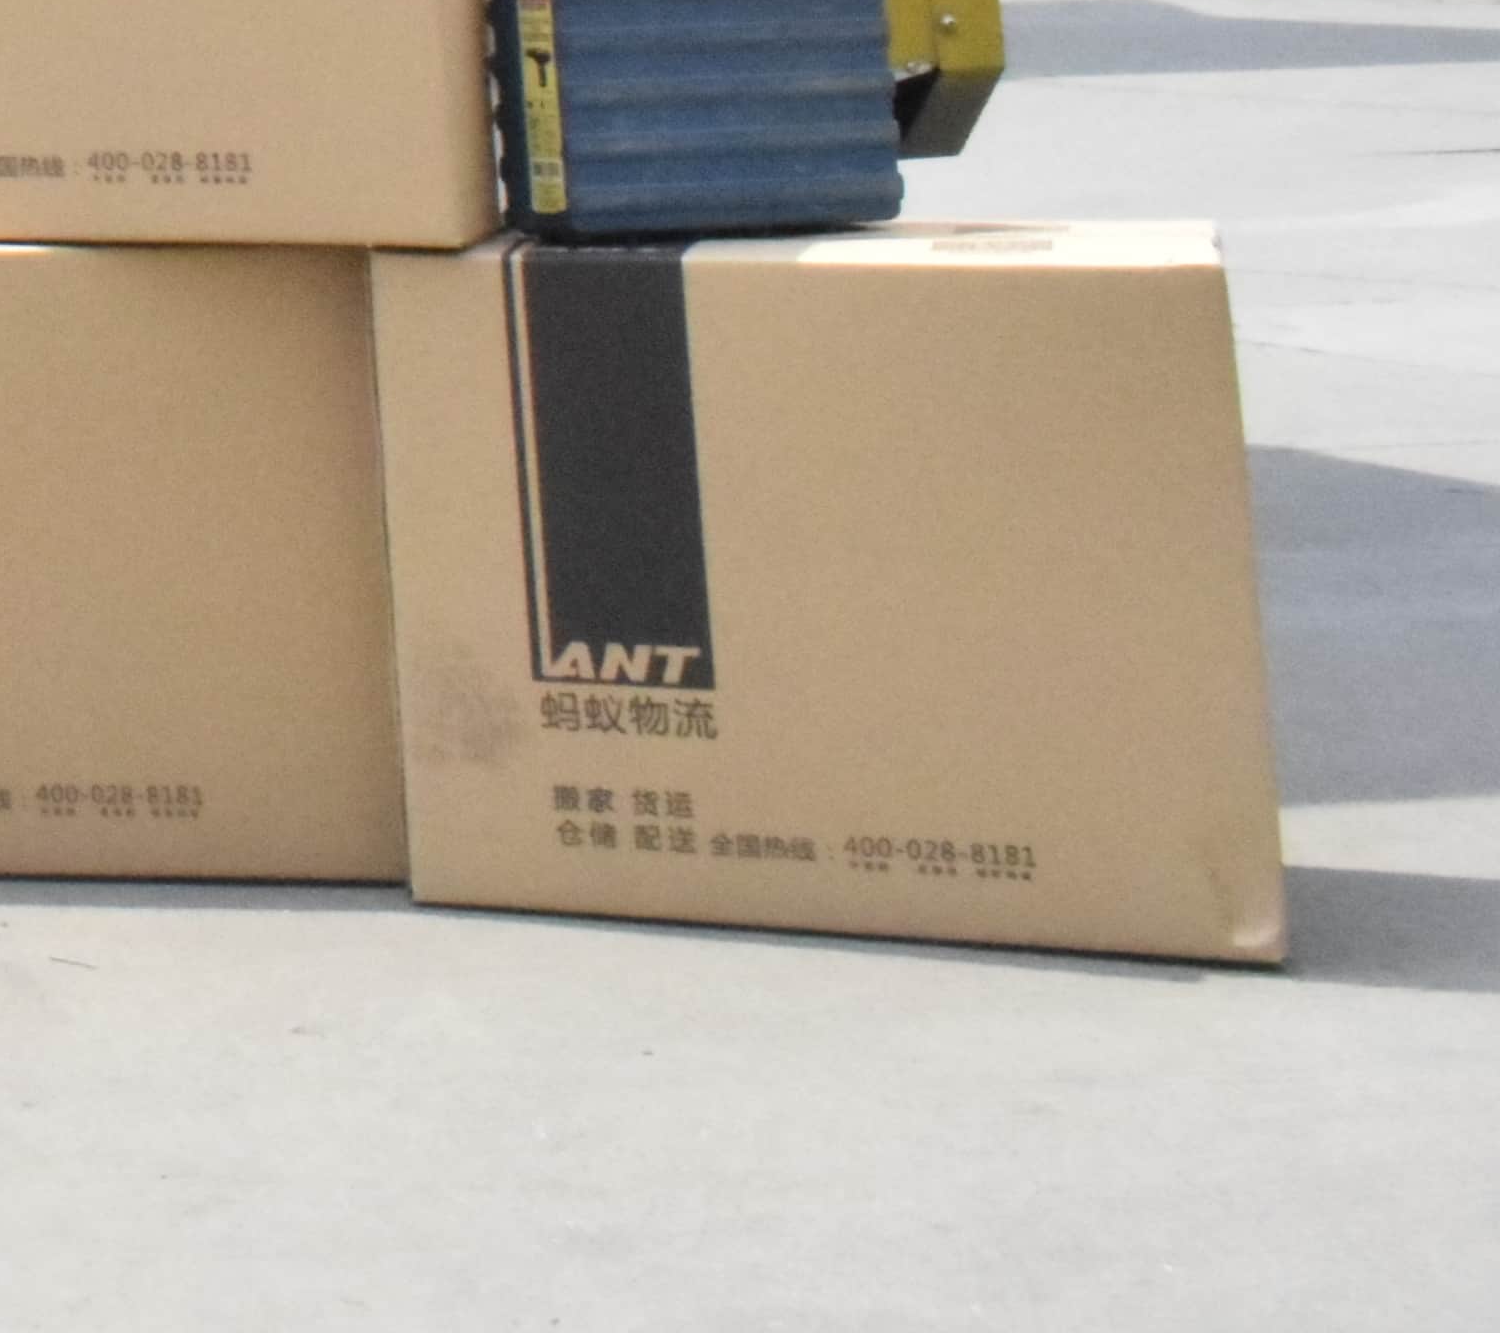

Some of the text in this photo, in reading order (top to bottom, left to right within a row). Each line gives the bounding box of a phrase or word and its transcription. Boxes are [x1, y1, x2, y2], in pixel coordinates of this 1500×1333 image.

[87, 150, 253, 173] 400-028-8181
[544, 641, 702, 684] ANT
[540, 690, 718, 740] 蚂蚁物流
[843, 835, 1038, 870] 400-028-8181
